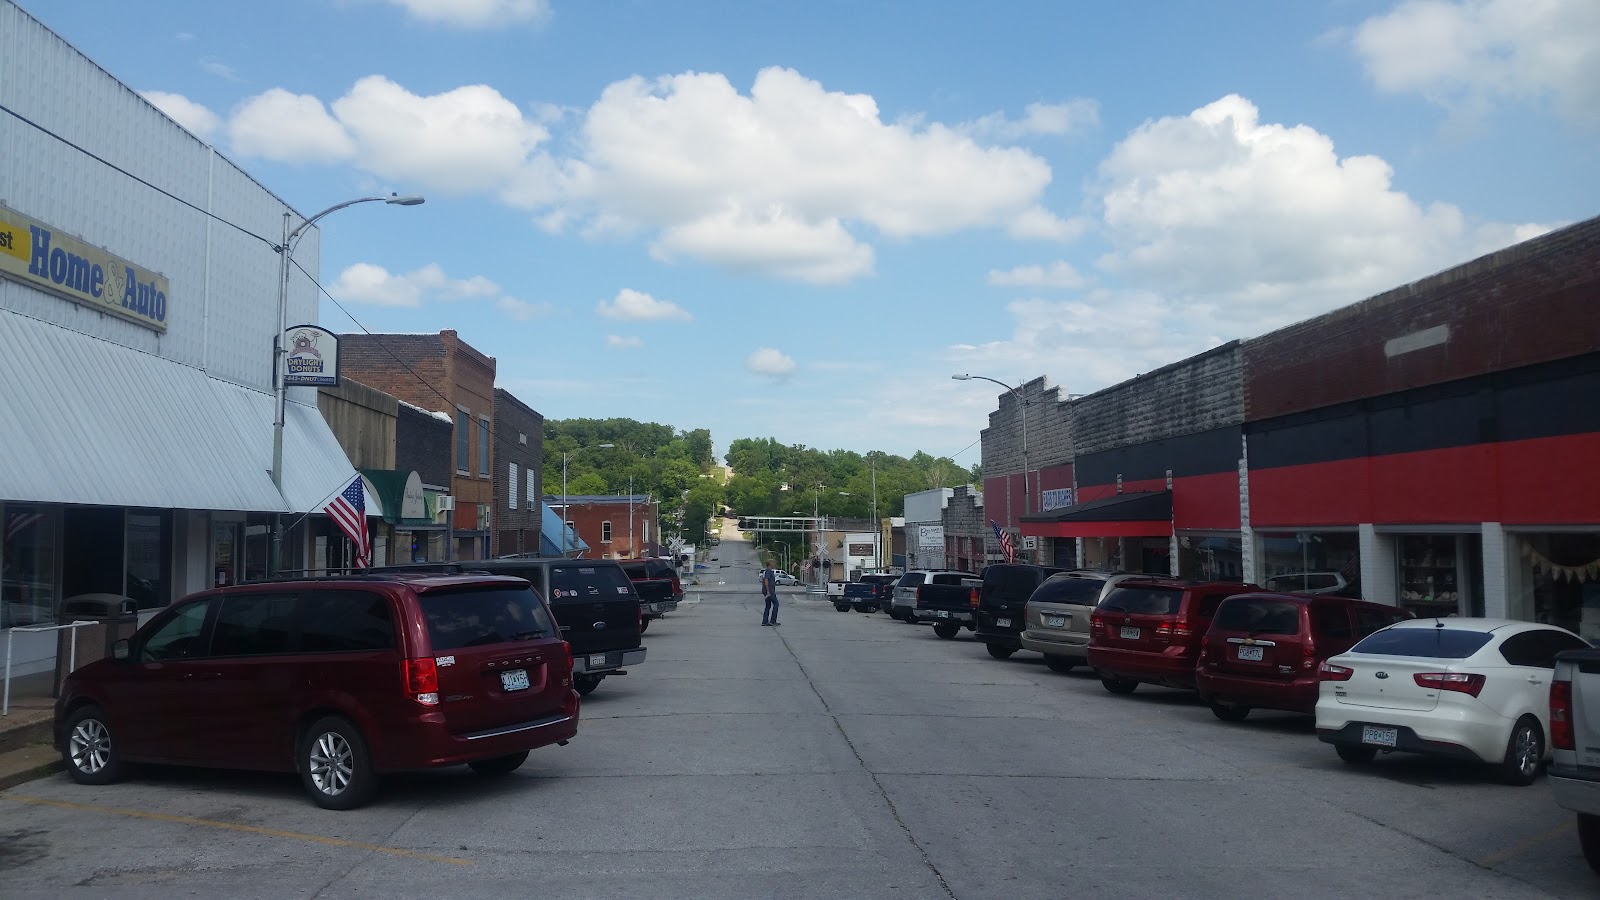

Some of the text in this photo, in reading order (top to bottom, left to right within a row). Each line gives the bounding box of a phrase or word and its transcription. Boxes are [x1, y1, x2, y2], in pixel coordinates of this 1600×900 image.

[28, 224, 167, 322] Home & Auto
[289, 359, 322, 367] DAYLIGHT
